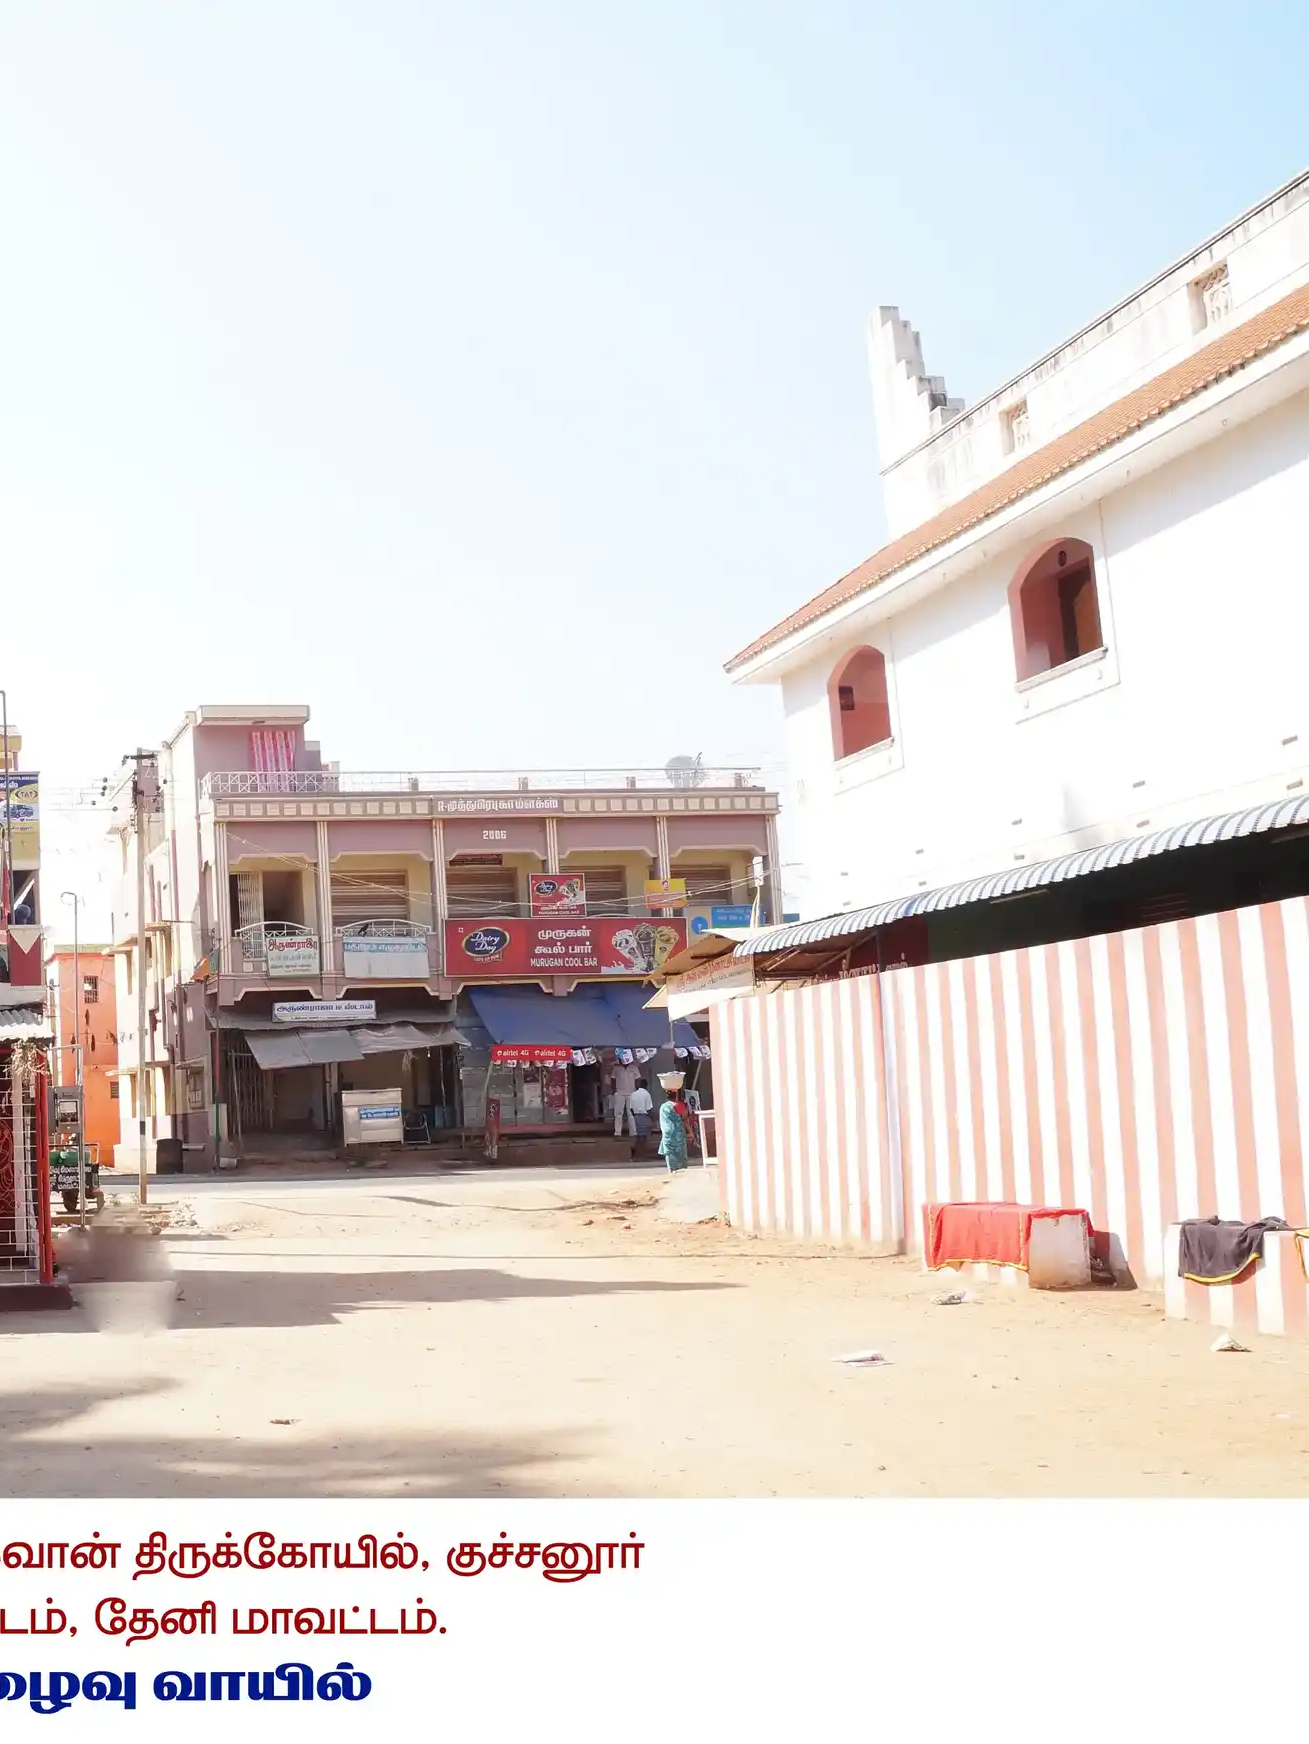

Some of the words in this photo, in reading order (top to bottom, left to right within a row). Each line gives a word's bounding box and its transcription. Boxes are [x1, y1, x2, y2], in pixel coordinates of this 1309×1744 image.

[483, 830, 507, 840] 2006
[470, 931, 501, 945] Dairy
[538, 925, 592, 940] முருகன்
[474, 941, 499, 954] Day
[534, 942, 565, 954] கூல்
[569, 941, 592, 953] பார்
[530, 957, 563, 967] MURUGAN
[565, 957, 584, 967] COOL
[585, 957, 598, 967] BAR
[540, 1049, 556, 1057] airtel
